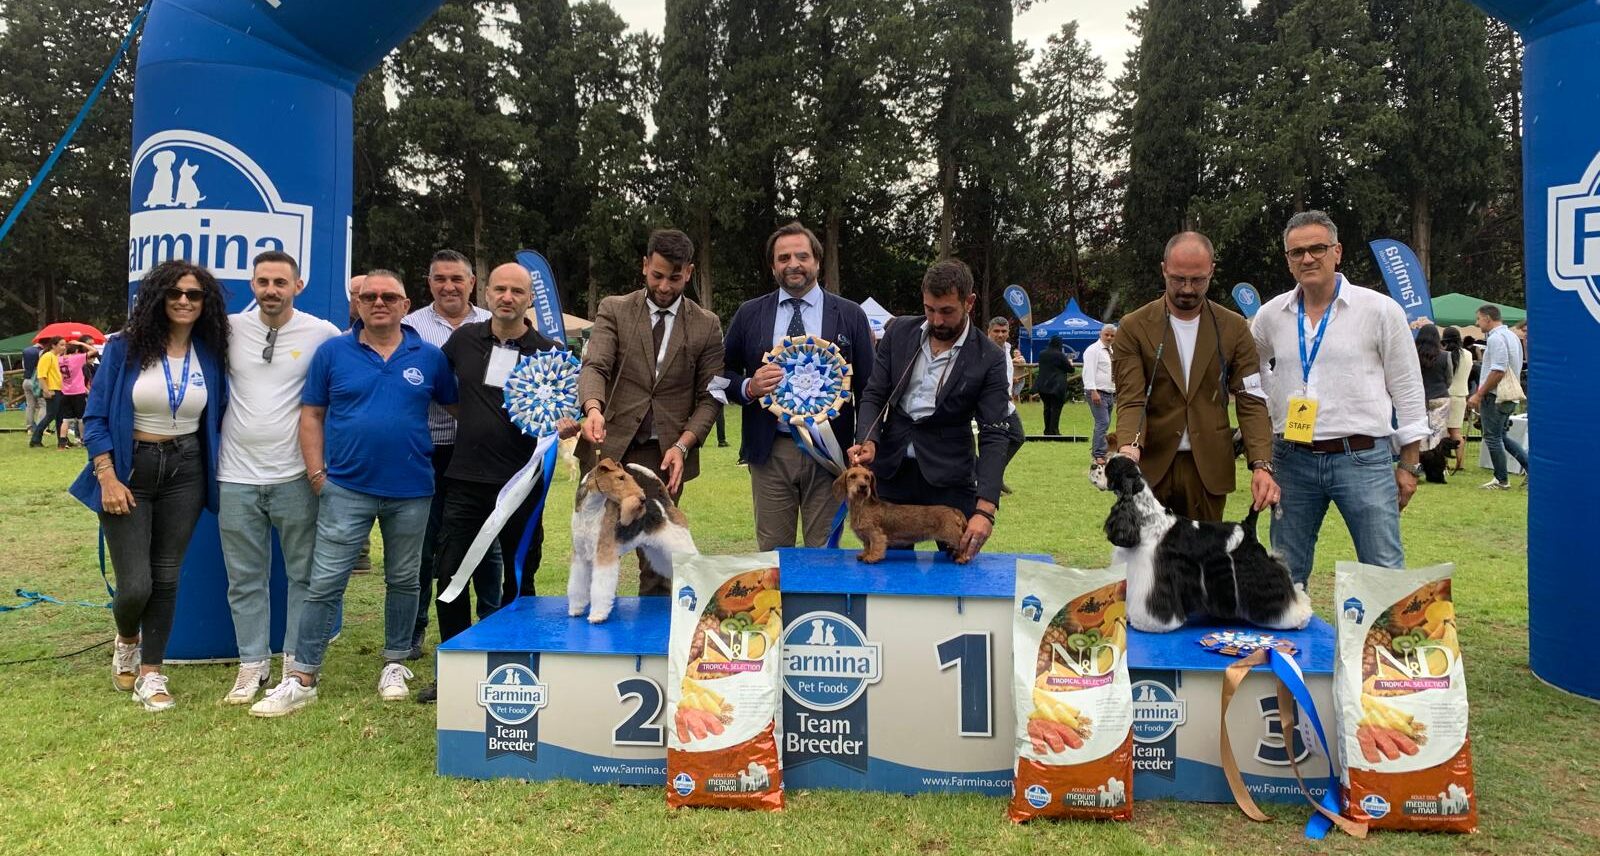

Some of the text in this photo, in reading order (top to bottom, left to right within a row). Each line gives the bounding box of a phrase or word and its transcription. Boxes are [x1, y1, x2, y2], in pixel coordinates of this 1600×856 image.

[129, 217, 285, 273] armin
[1288, 421, 1311, 431] STAFF
[701, 629, 770, 661] N&D
[1050, 642, 1120, 677] N&D
[1375, 644, 1455, 679] N&D
[702, 663, 761, 671] TROPICAL SELECTION
[798, 681, 848, 693] Pet Foods
[935, 630, 992, 737] 1
[1052, 676, 1112, 685] TROPICAL SELECTION
[1380, 680, 1449, 688] TROPICAL SELECTION
[484, 686, 541, 702] Farmina
[497, 706, 527, 714] Pet Foods
[613, 676, 664, 746] 2
[1132, 704, 1179, 719] rmina
[796, 712, 851, 734] Team
[1145, 724, 1164, 732] Foods
[1254, 693, 1311, 766] 3
[496, 725, 528, 738] Team
[488, 737, 535, 751] Breeder
[786, 732, 864, 755] Breeder
[1132, 744, 1166, 757] Team
[592, 764, 667, 775] www.Farmina.c
[1132, 757, 1174, 770] reeder
[1246, 783, 1328, 796] ww.Farmina.co
[1066, 793, 1096, 801] MEDIUM
